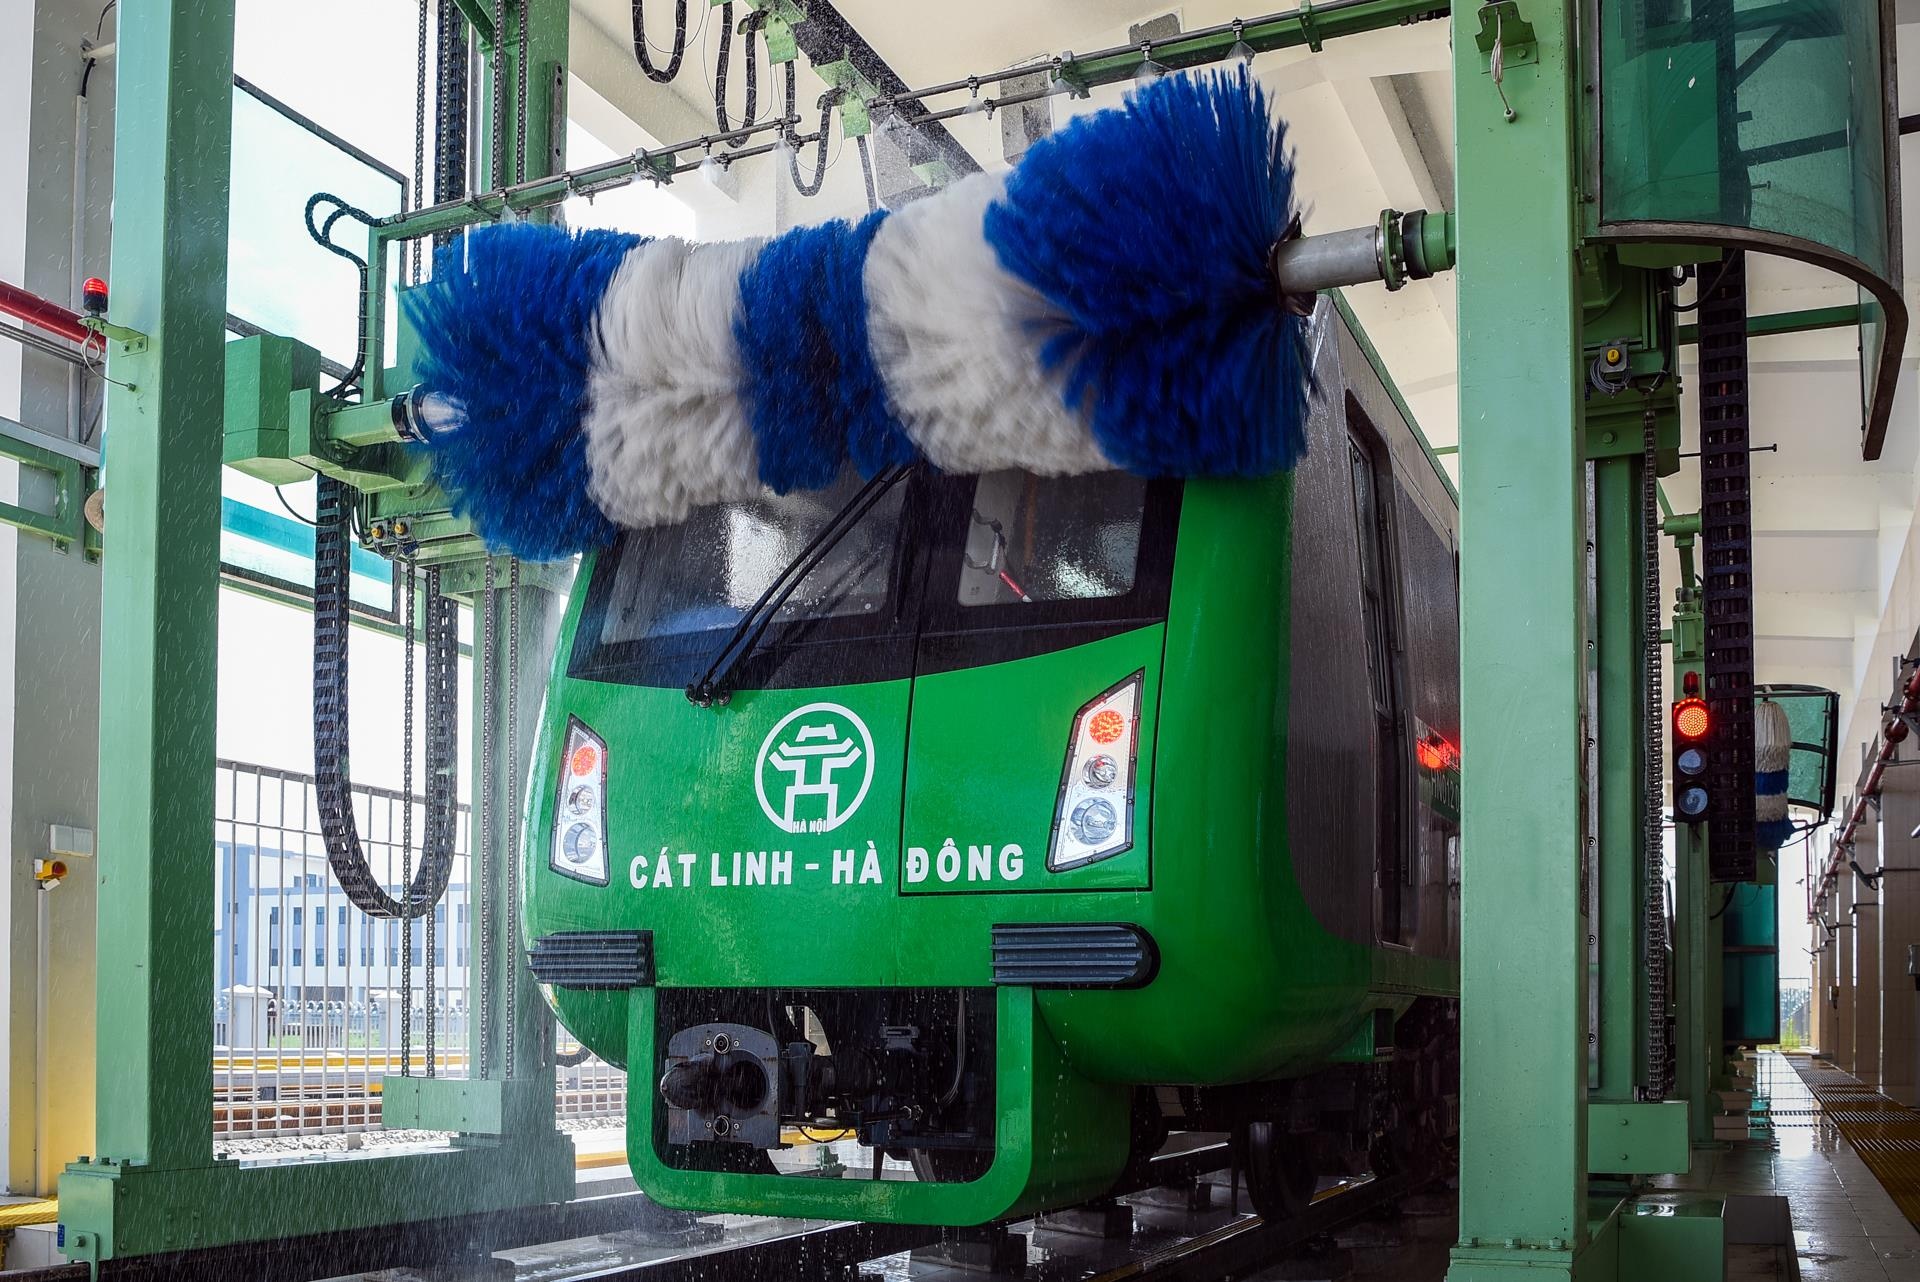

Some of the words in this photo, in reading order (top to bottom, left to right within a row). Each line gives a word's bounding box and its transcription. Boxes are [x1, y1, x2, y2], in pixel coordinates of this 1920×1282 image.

[793, 818, 807, 833] HÀ
[809, 818, 827, 835] NỘI
[629, 847, 697, 889] CÁT
[710, 850, 793, 887] LINH
[831, 840, 883, 884] HÀ
[906, 837, 1025, 882] ĐÔNG
